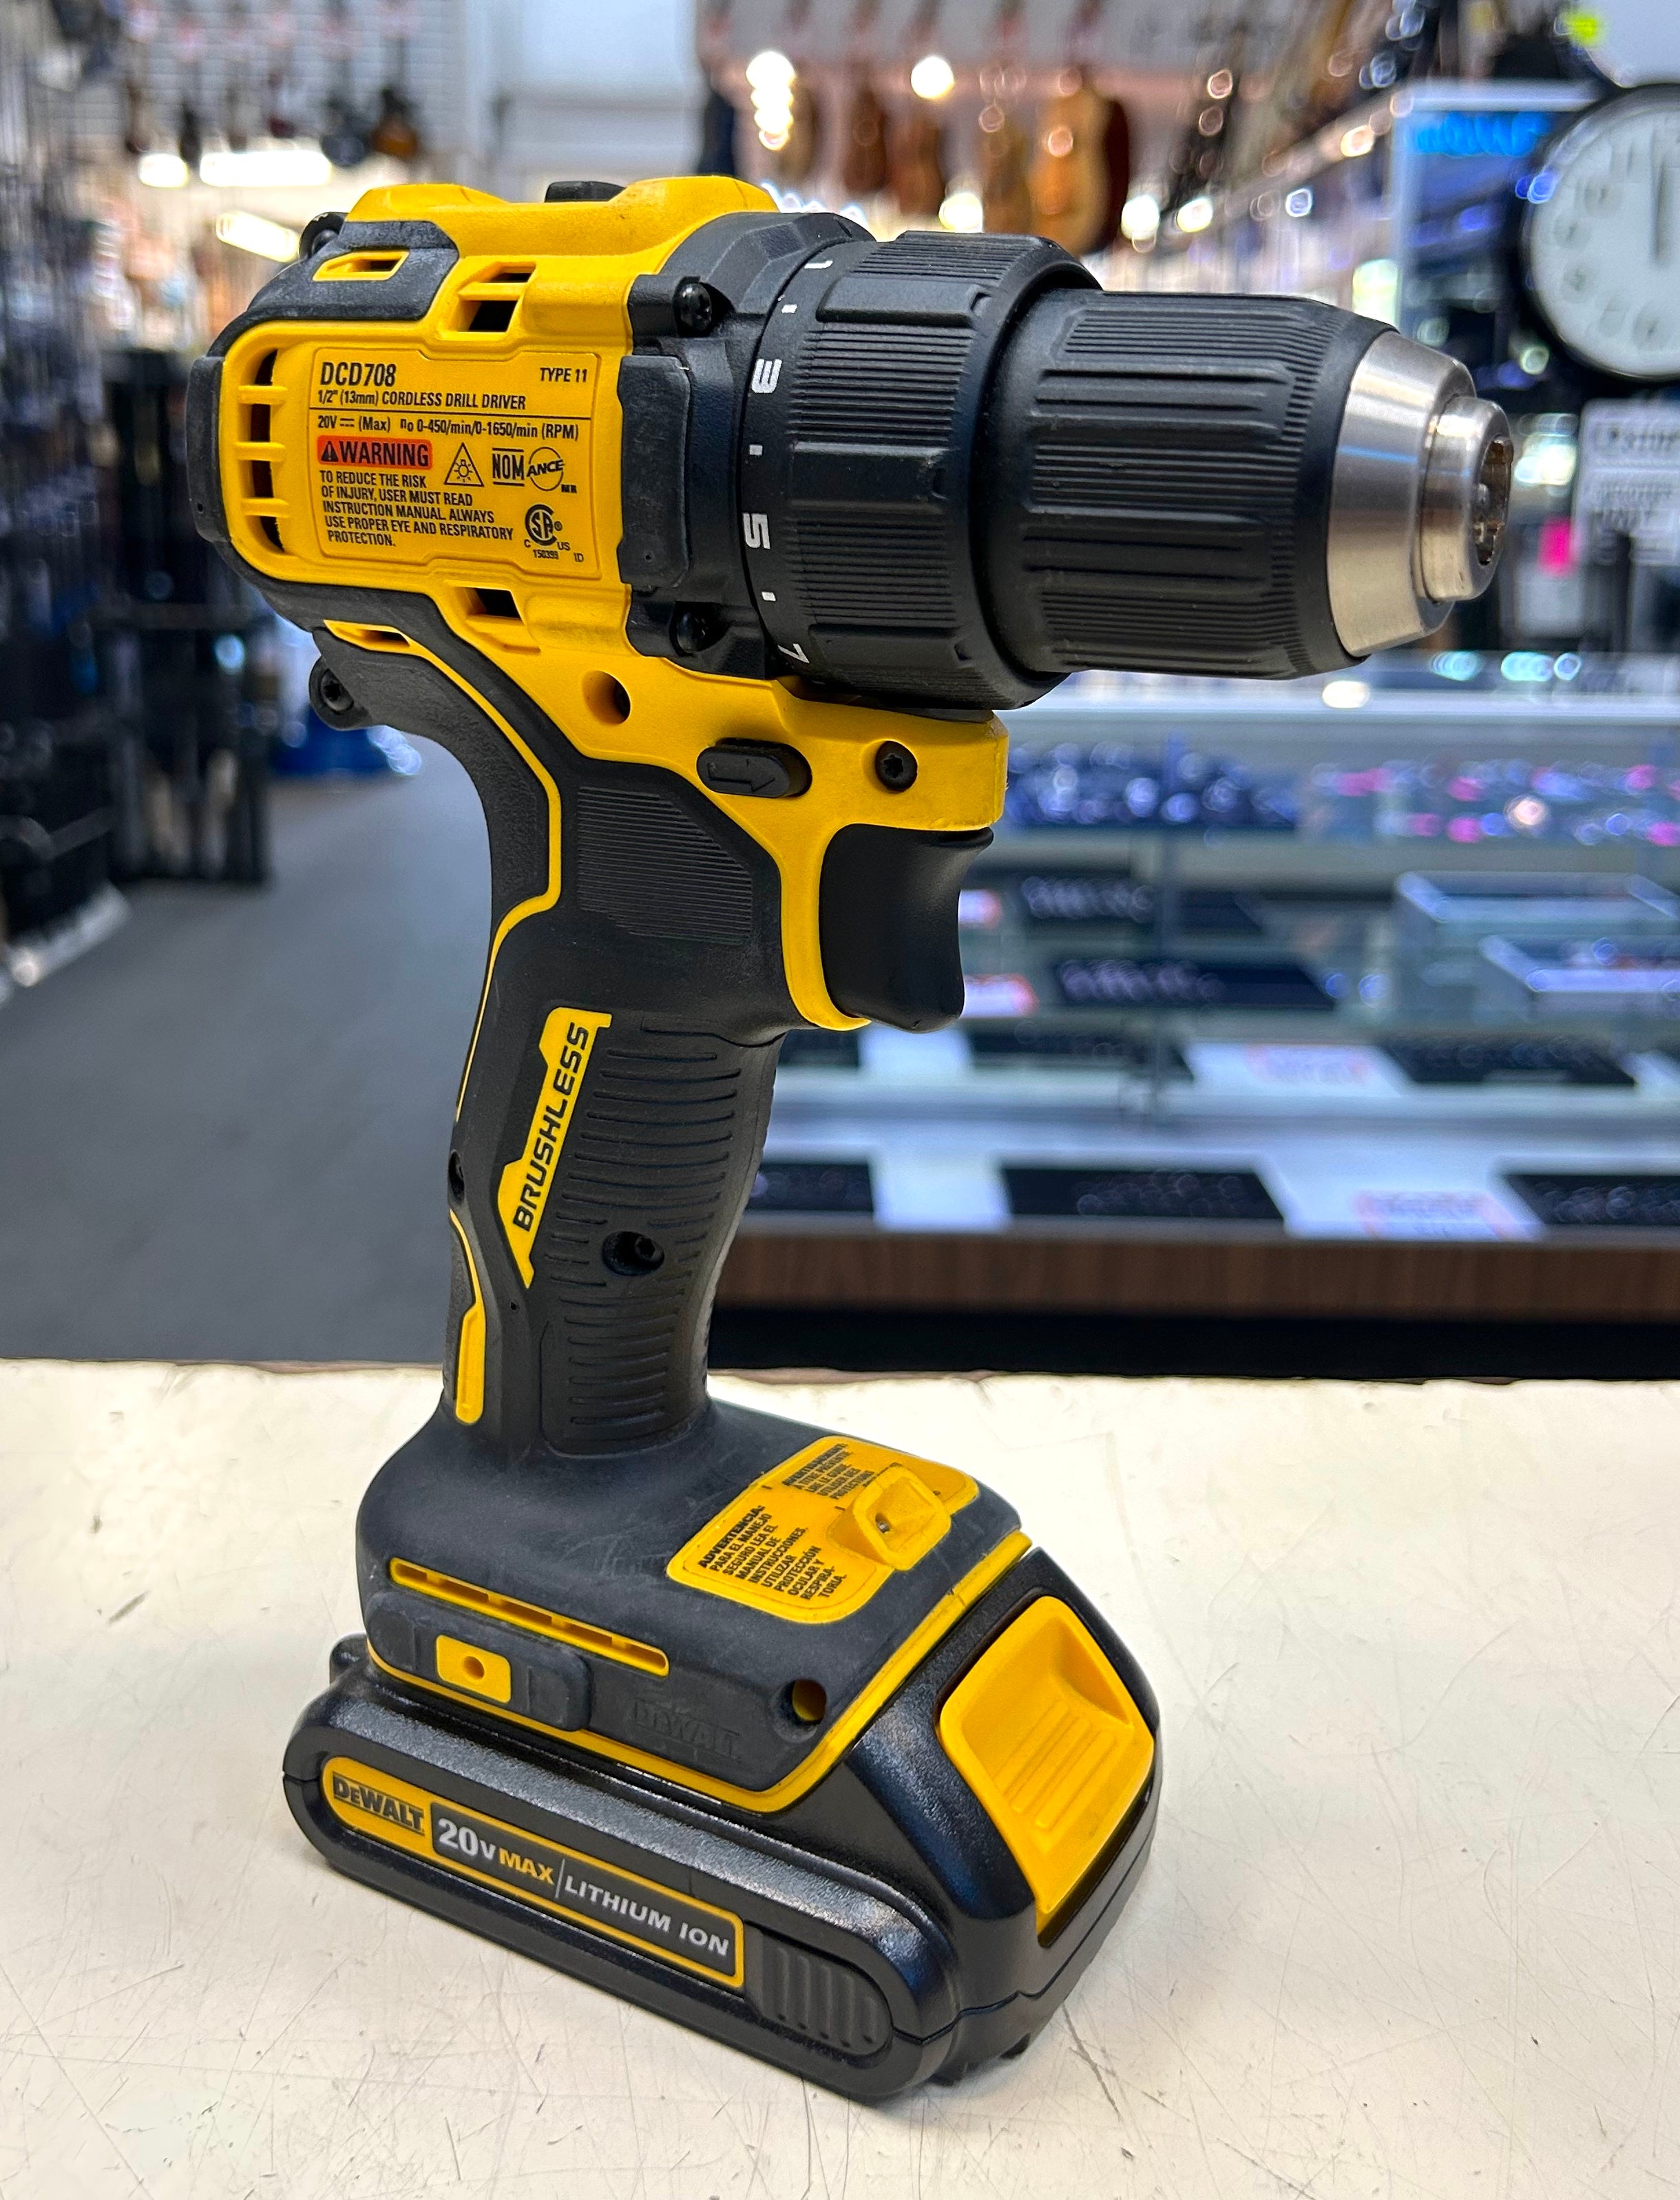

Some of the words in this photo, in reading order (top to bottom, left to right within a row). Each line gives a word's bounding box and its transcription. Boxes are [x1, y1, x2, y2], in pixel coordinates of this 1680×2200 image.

[320, 362, 397, 387] DCD708
[540, 367, 572, 382] TYPE
[575, 368, 587, 383] 11
[751, 358, 782, 394] 3
[318, 389, 338, 405] 1/2"
[340, 390, 379, 406] (13mm)
[382, 391, 442, 407] CORDLESS
[445, 392, 479, 408] DRILL
[482, 394, 526, 410] DRIVER
[317, 415, 337, 428] 20V
[359, 416, 391, 433] (Max)
[542, 423, 579, 441] (RPM)
[339, 441, 429, 467] WARNING
[492, 453, 525, 481] NOM
[319, 470, 333, 483] TO
[336, 471, 377, 485] REDUCE
[379, 473, 399, 487] THE
[402, 474, 427, 488] RISK
[526, 459, 565, 477] ANCE
[322, 485, 334, 498] OF
[336, 486, 377, 502] INJURY,
[379, 488, 407, 503] USER
[409, 490, 441, 505] MUST
[443, 492, 473, 506] READ
[322, 500, 393, 516] INSTRUCTION
[449, 508, 494, 523] ALWAYS
[324, 515, 346, 528] USE
[347, 516, 389, 532] PROPER
[390, 519, 411, 533] EYE
[414, 521, 437, 534] AND
[439, 523, 514, 541] RESPIRATORY
[328, 528, 397, 547] PROTECTION.
[742, 512, 771, 549] 5
[557, 541, 571, 551] US
[778, 642, 810, 664] 7
[512, 1021, 590, 1231] BRUSHLESS
[708, 1551, 736, 1571] PARA
[728, 1543, 745, 1551] EL
[737, 1513, 773, 1542] MANEJO
[722, 1545, 756, 1575] SEGURO
[749, 1533, 770, 1547] LEA
[762, 1525, 779, 1533] EL
[734, 1547, 773, 1580] MANUAL
[764, 1536, 782, 1547] DE
[760, 1554, 798, 1588] UTILIZAR
[773, 1545, 822, 1592] PROTECCIÓN
[787, 1564, 821, 1596] OCULAR
[498, 1849, 554, 1886] MAX
[565, 1874, 672, 1932] LITHIUM
[679, 1920, 730, 1957] ION
